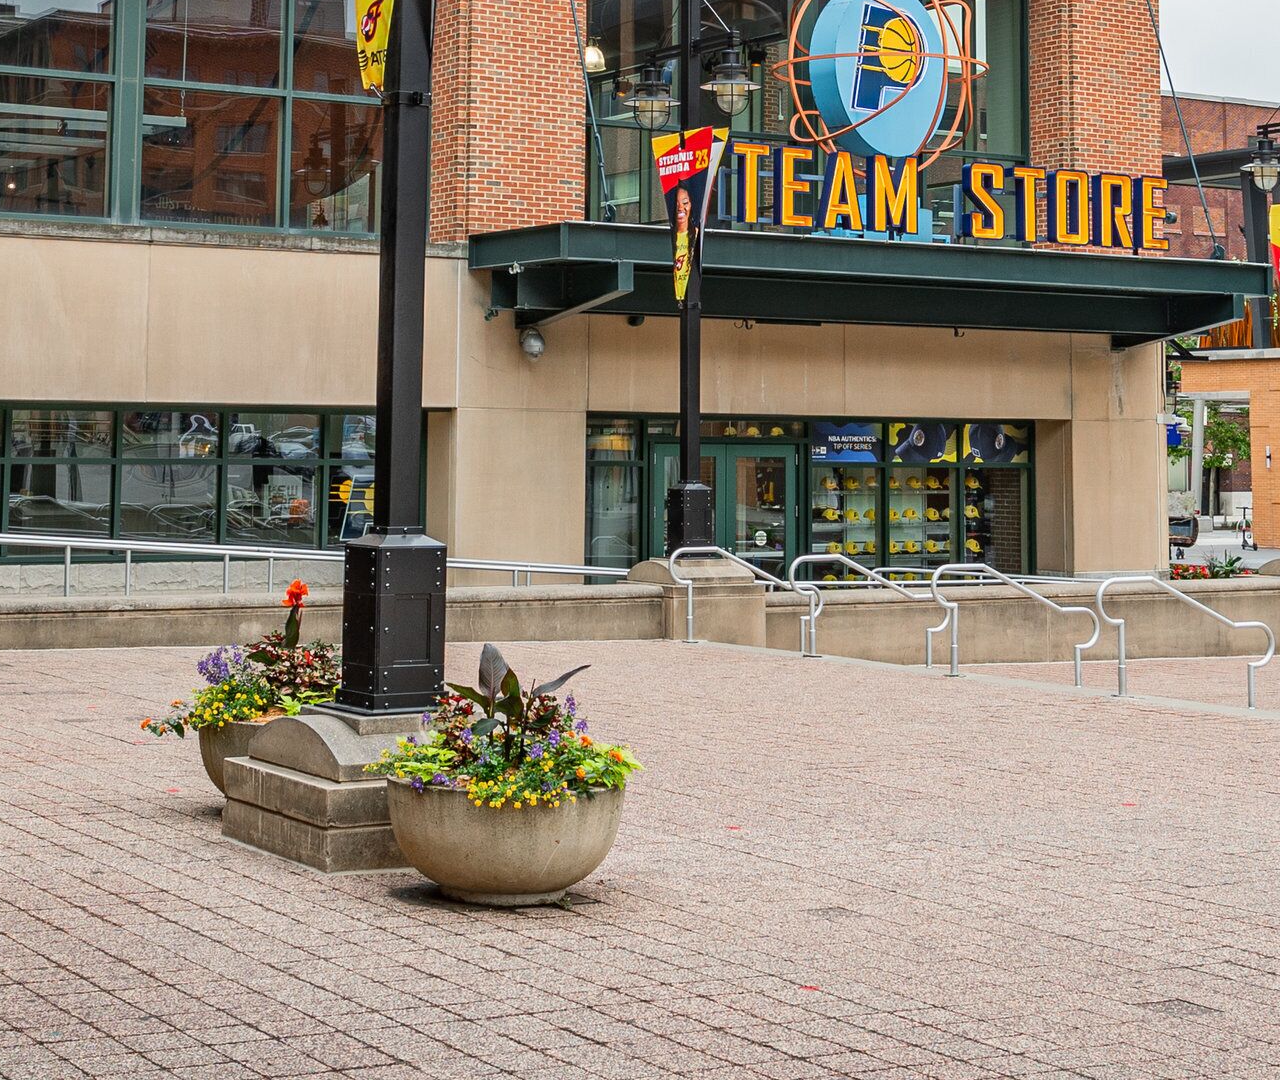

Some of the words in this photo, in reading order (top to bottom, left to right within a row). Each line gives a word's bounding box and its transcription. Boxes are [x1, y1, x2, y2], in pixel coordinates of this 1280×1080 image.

[695, 148, 709, 169] 23
[731, 139, 920, 235] TEAM
[961, 161, 1170, 252] STORE
[827, 435, 840, 443] NBA
